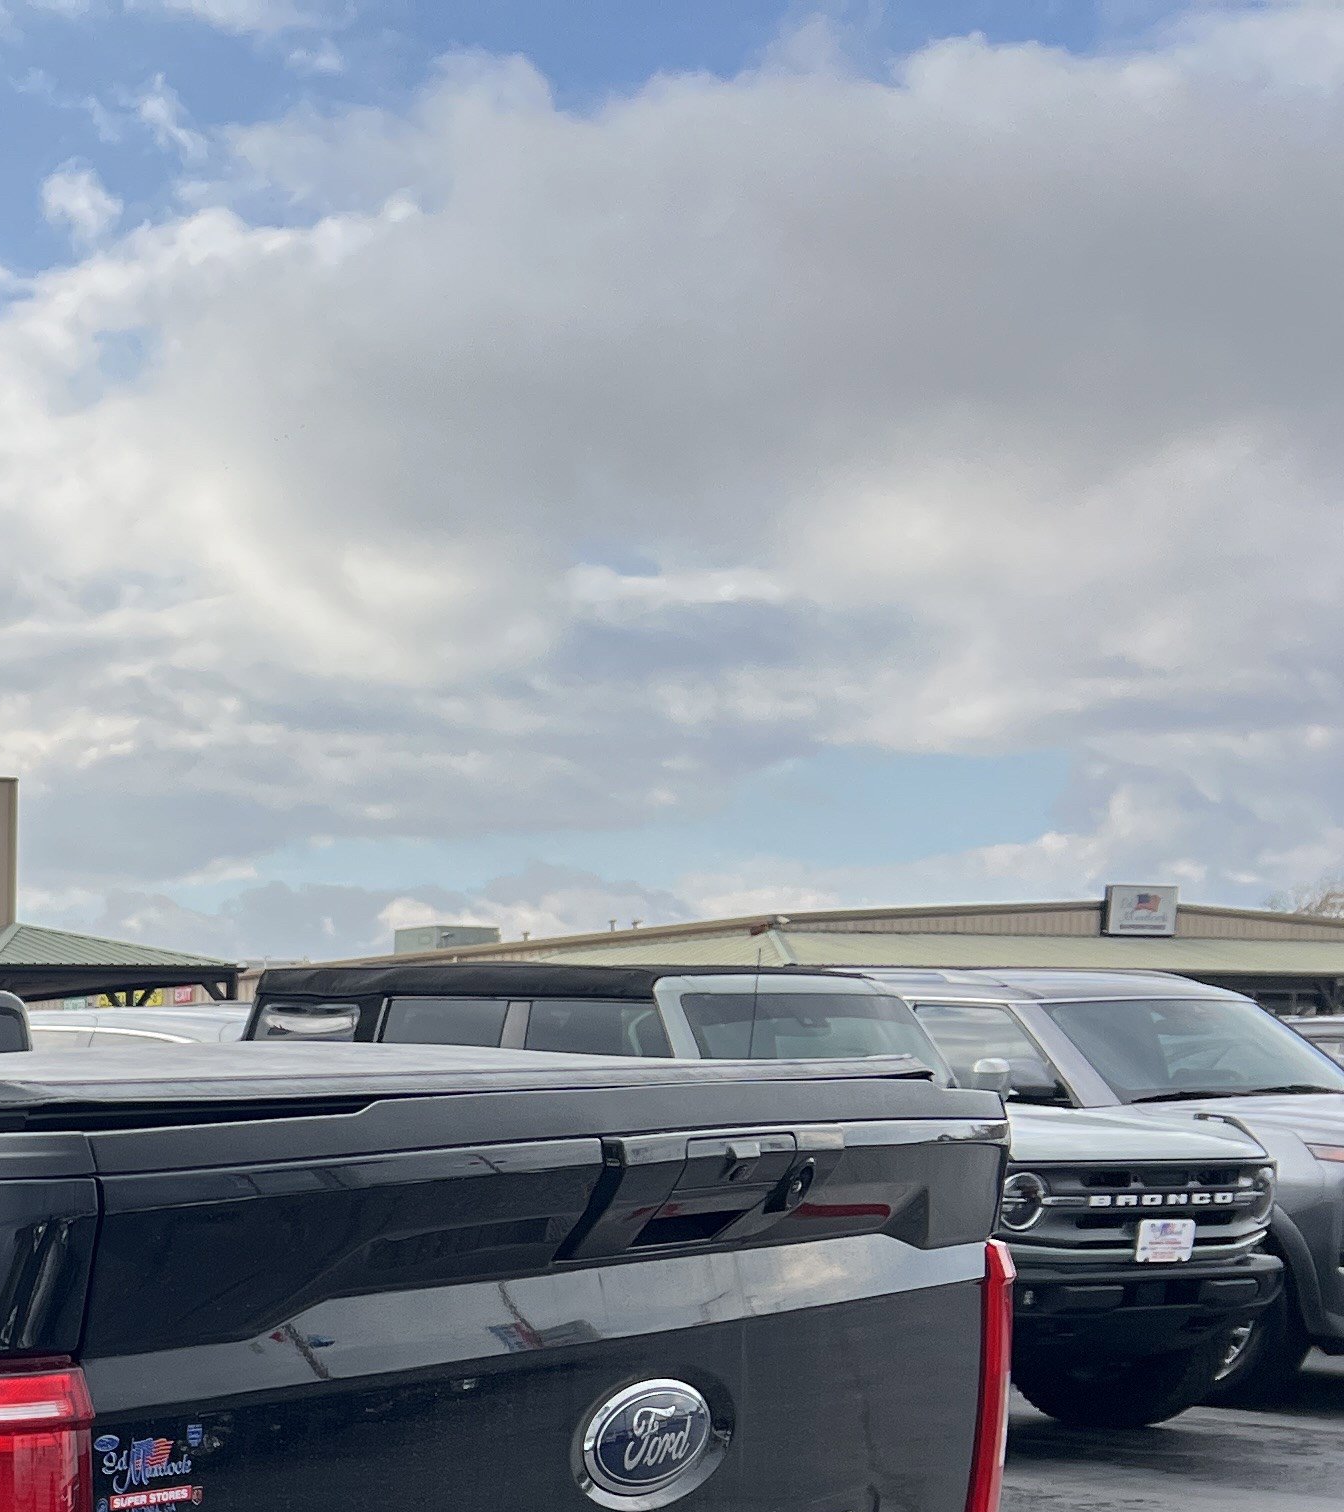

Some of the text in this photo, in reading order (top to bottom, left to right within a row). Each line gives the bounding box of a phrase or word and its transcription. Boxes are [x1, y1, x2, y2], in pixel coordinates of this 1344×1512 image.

[1088, 1192, 1234, 1207] BRONCO
[624, 1405, 693, 1471] Ford
[101, 1450, 128, 1475] Ed
[113, 1494, 147, 1509] SUPER
[149, 1489, 188, 1502] STORES
